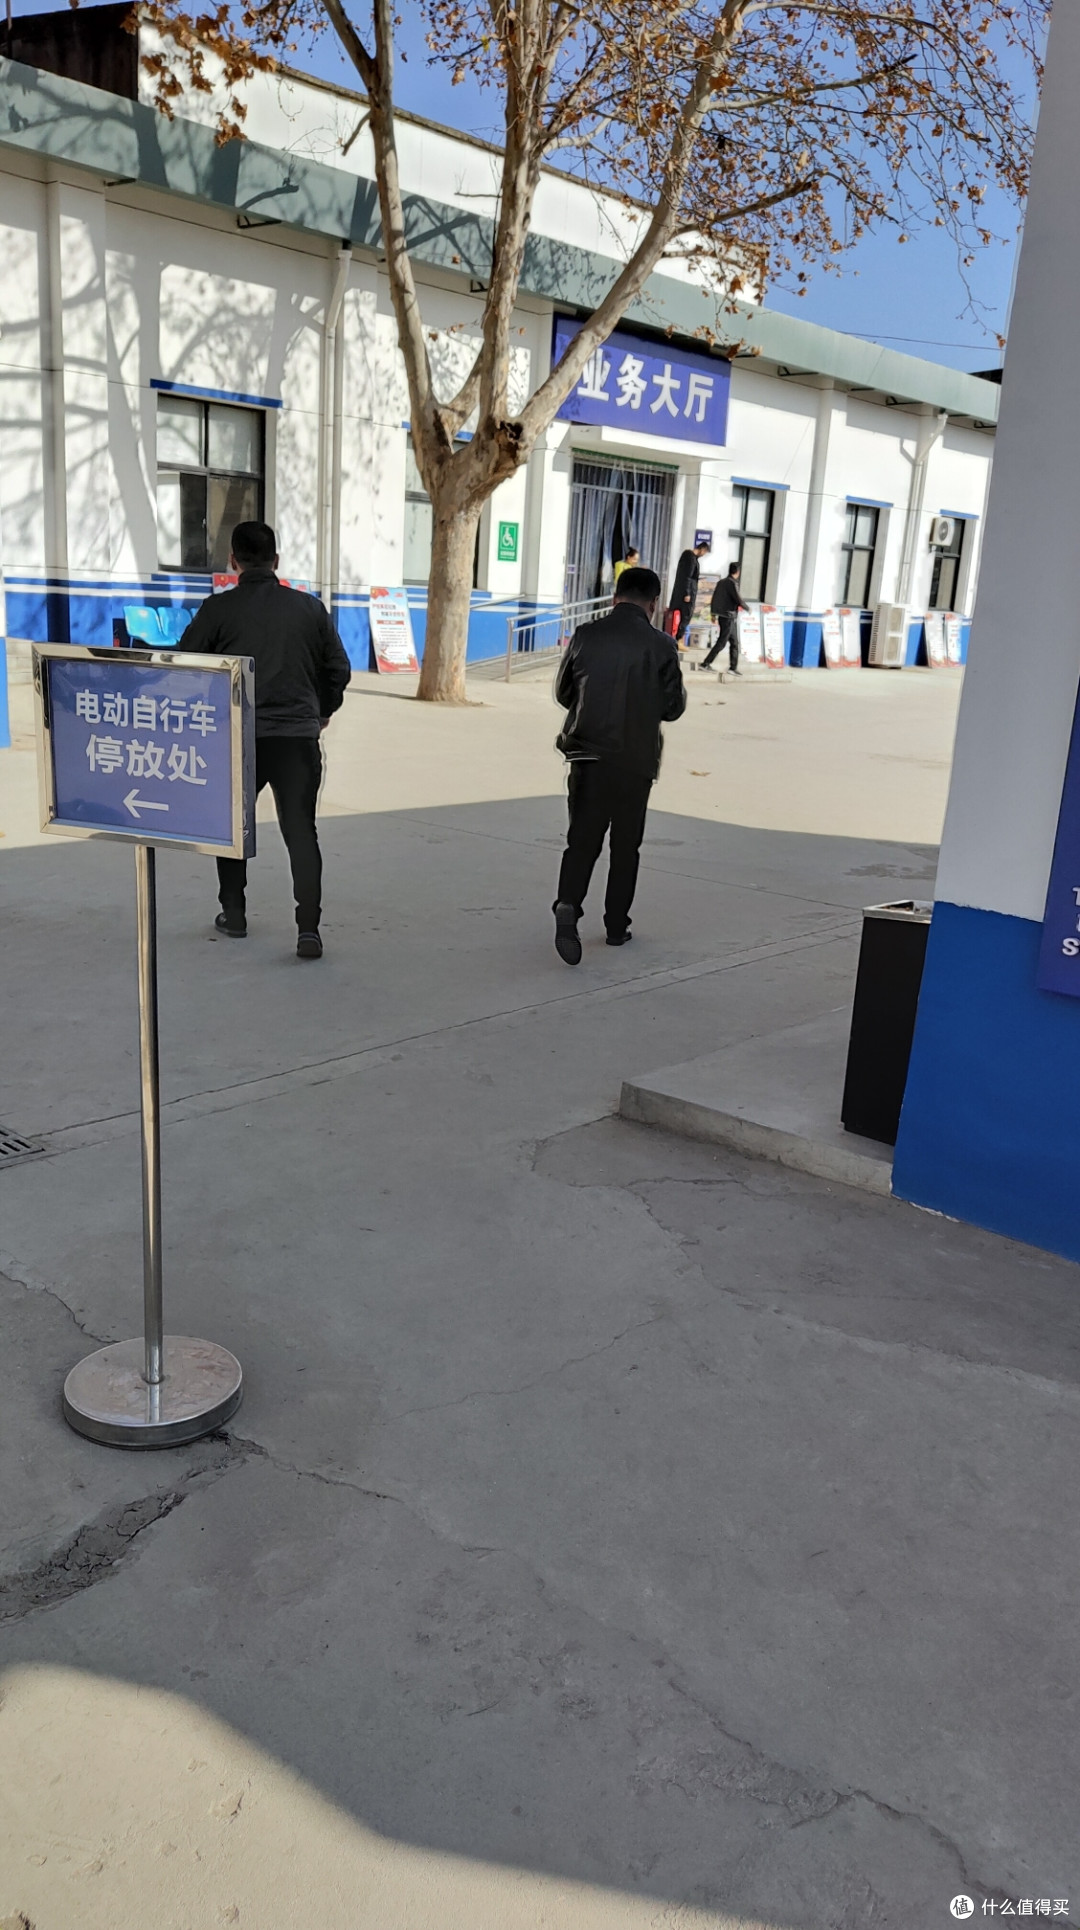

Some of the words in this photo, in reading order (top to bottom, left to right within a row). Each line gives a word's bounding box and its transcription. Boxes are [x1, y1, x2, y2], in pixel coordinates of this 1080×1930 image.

[577, 347, 714, 423] 业务大厅
[75, 689, 217, 738] 电动自行车
[85, 734, 208, 786] 停放处
